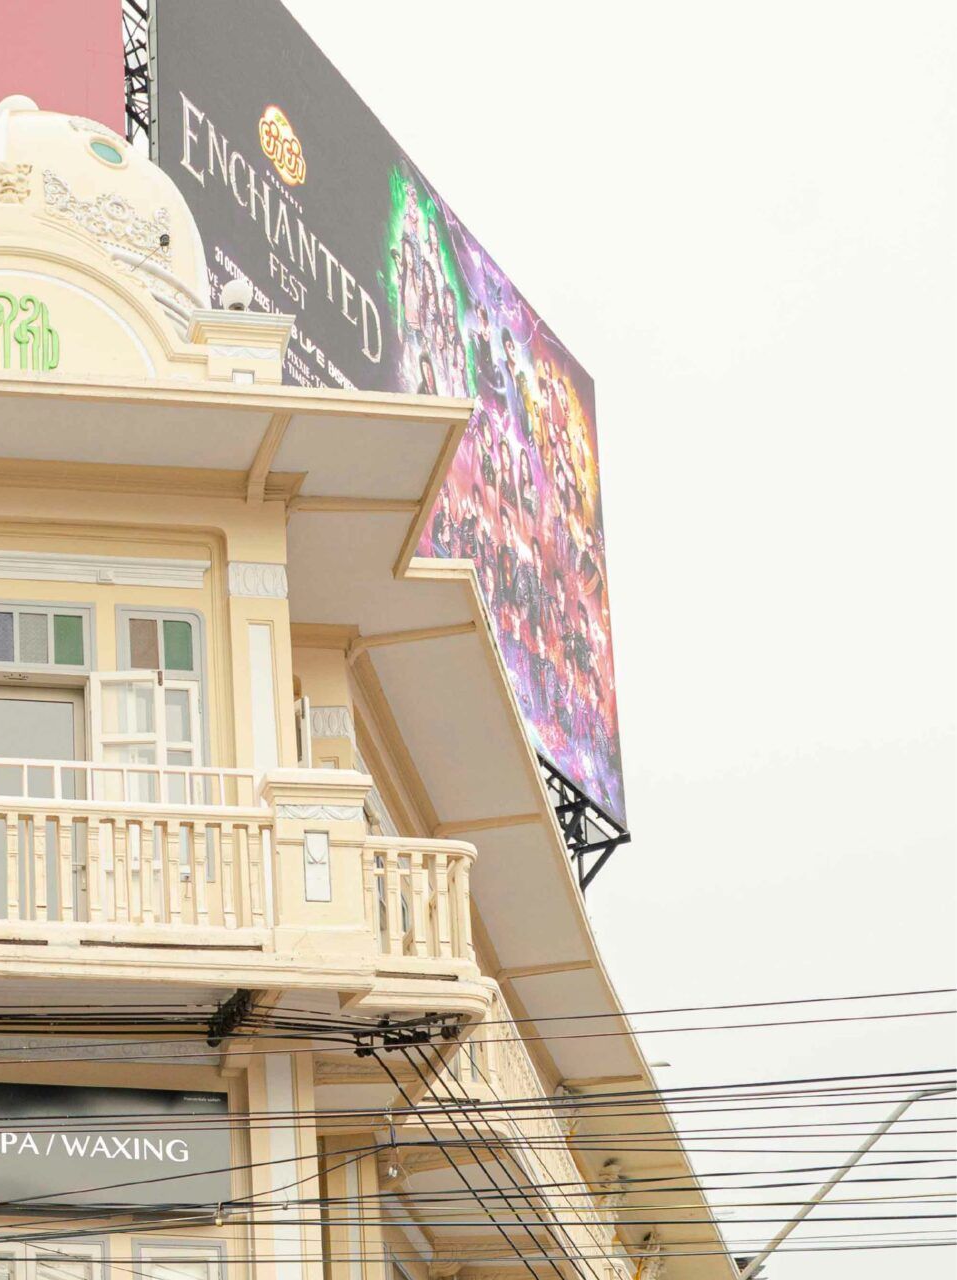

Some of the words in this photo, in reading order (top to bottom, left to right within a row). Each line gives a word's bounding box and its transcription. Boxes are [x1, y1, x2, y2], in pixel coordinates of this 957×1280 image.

[179, 90, 382, 364] ENCHANTED
[254, 286, 270, 312] 2025
[269, 252, 308, 310] FEST
[61, 1134, 190, 1163] WAXING
